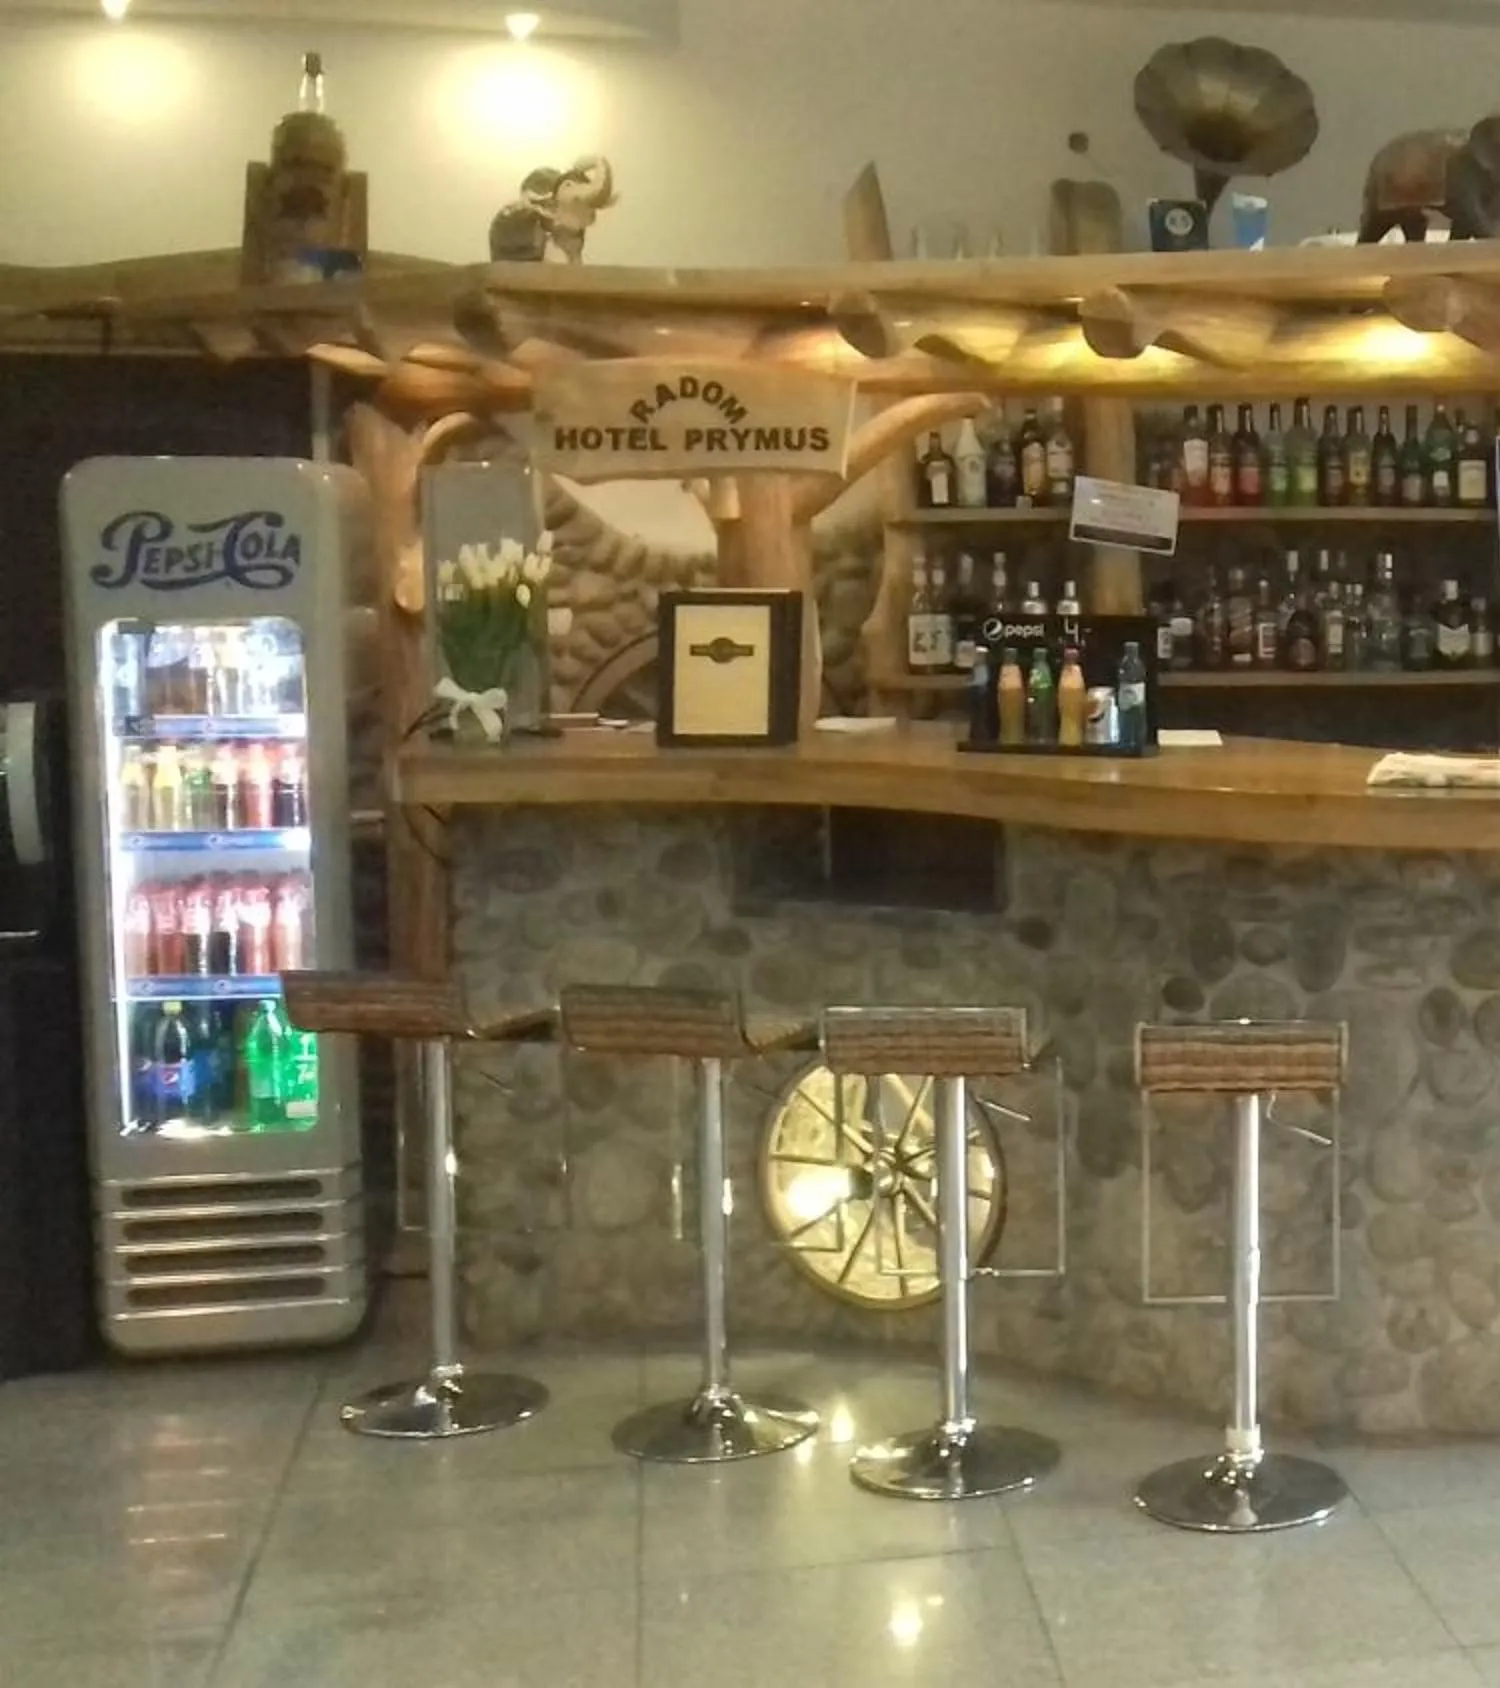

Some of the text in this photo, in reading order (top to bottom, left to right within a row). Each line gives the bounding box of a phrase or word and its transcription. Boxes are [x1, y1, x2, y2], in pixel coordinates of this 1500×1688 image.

[629, 375, 749, 425] RADOM
[554, 427, 831, 451] HOTEL PRYMUS
[1004, 623, 1044, 637] pepsi
